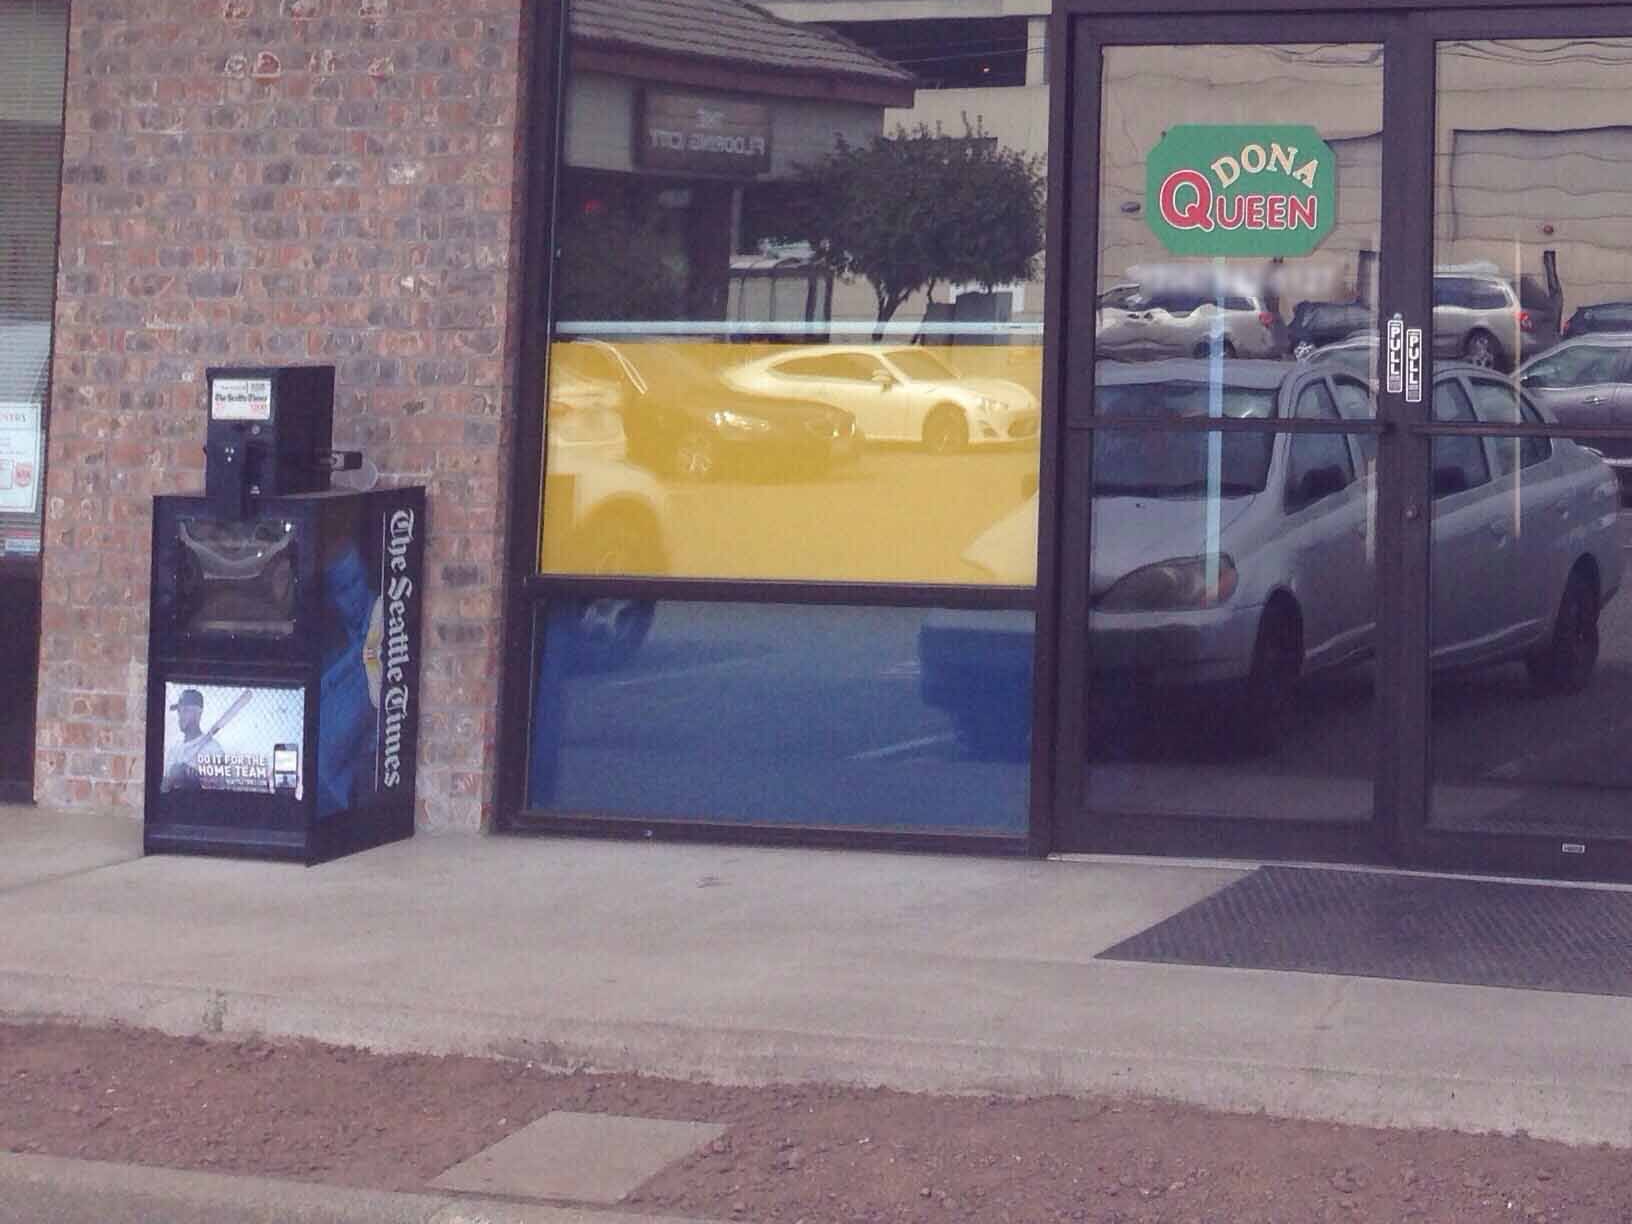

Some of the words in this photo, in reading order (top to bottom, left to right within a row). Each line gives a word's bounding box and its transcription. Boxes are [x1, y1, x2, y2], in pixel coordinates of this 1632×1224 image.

[1211, 143, 1319, 188] DONA
[1160, 169, 1317, 232] QUEEN
[1390, 327, 1400, 375] PULL
[1409, 335, 1419, 384] PULL
[387, 508, 414, 572] The
[386, 575, 412, 681] Seattle
[383, 685, 408, 788] Times
[199, 765, 231, 777] HOME
[235, 766, 267, 778] TEAM
